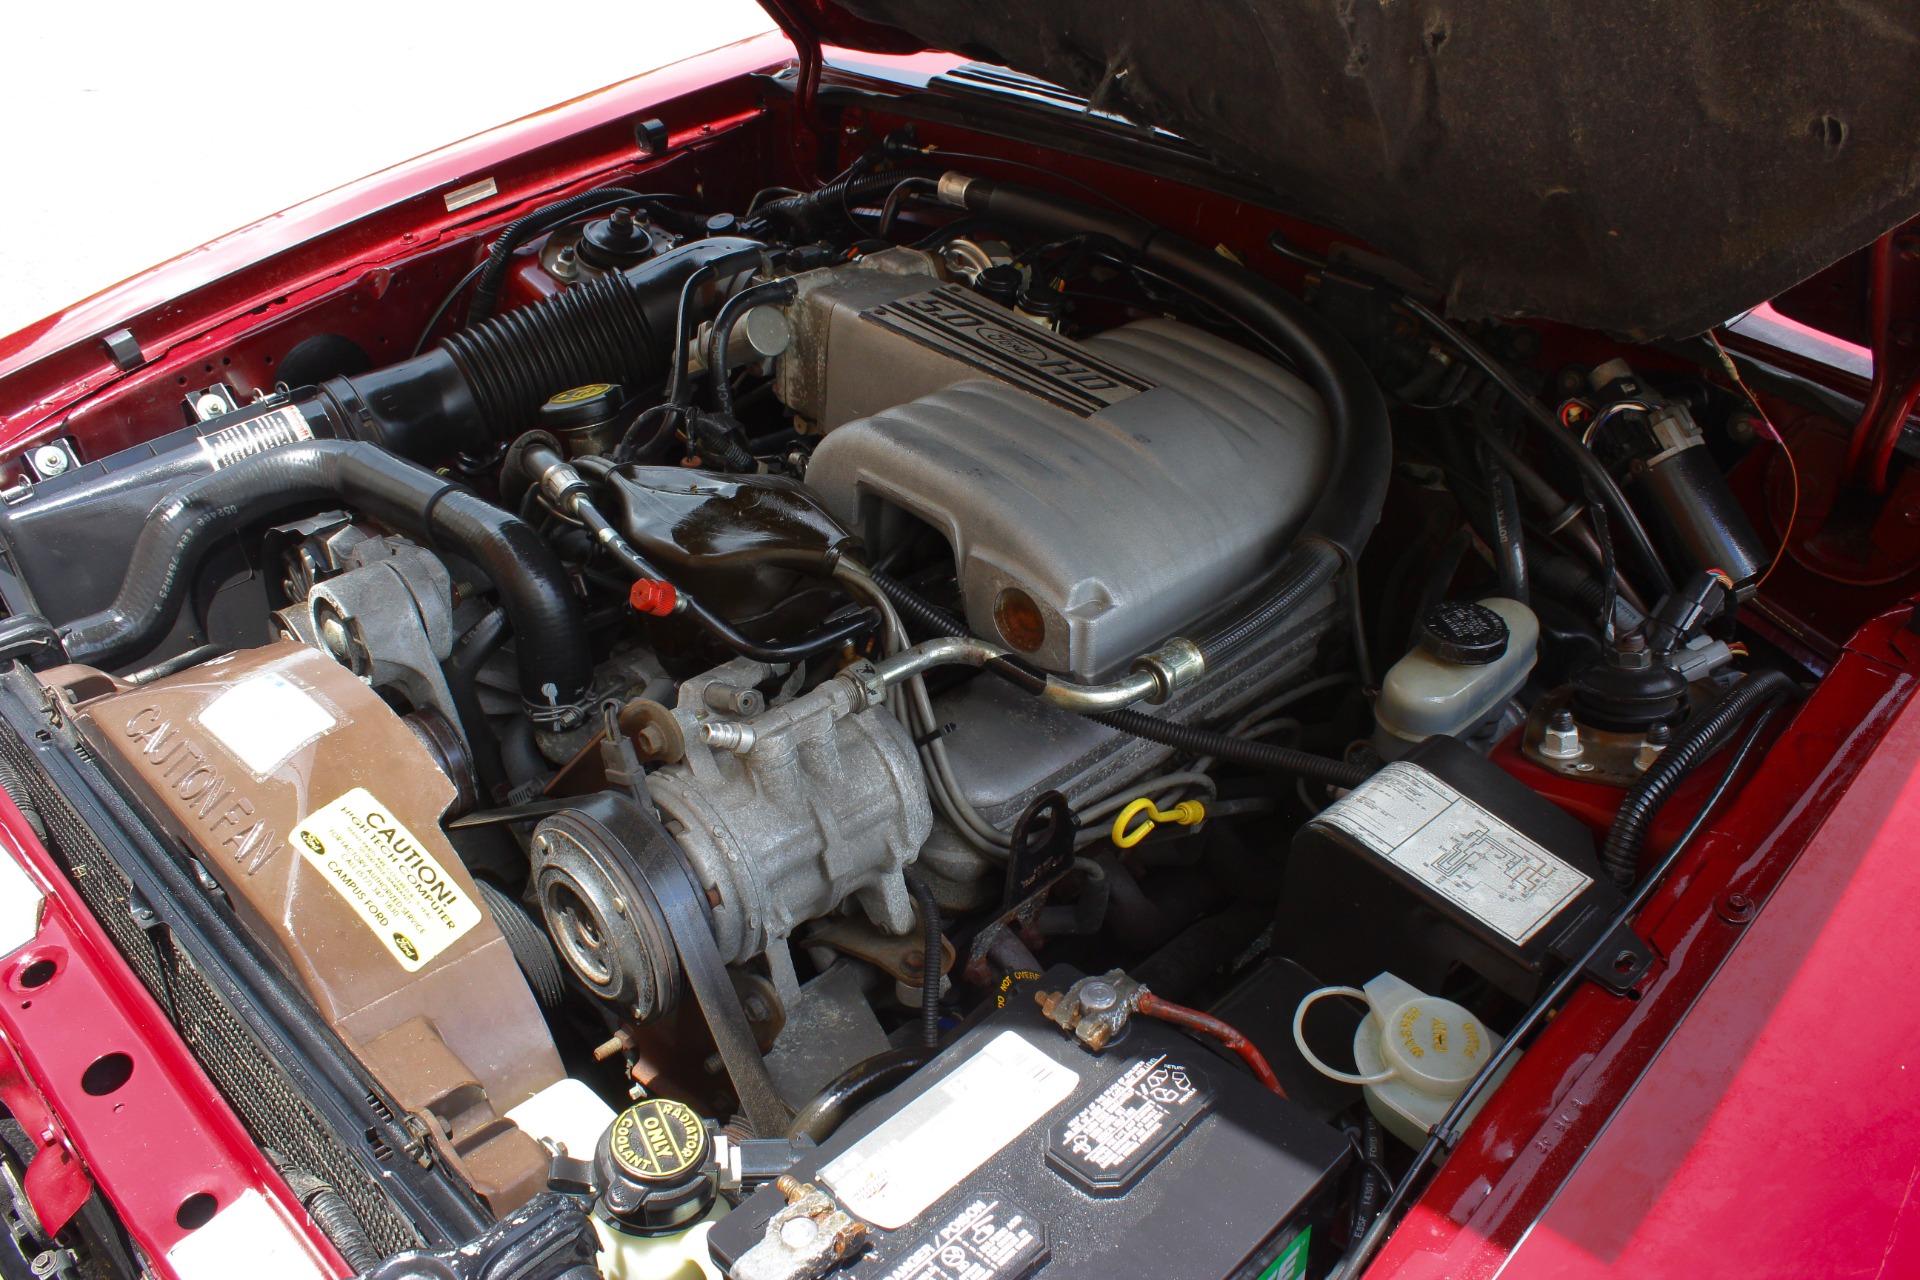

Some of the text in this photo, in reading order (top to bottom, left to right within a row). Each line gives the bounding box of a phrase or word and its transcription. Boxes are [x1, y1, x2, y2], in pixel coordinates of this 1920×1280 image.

[907, 299, 984, 327] 5.0
[126, 705, 284, 876] CAUTION FAN
[340, 839, 368, 870] FACTORY
[367, 868, 403, 908] AUTHORIZED
[402, 907, 426, 935] SERVICE
[341, 806, 456, 930] HIGH TECH COMPUTER
[366, 812, 457, 907] CAUTION!
[327, 860, 366, 901] CAMPUS
[365, 900, 389, 927] FORD
[616, 1118, 651, 1170] COOLANT
[643, 1117, 673, 1158] ONLY
[663, 1103, 698, 1158] RADIATOR
[940, 1199, 987, 1240] POISON
